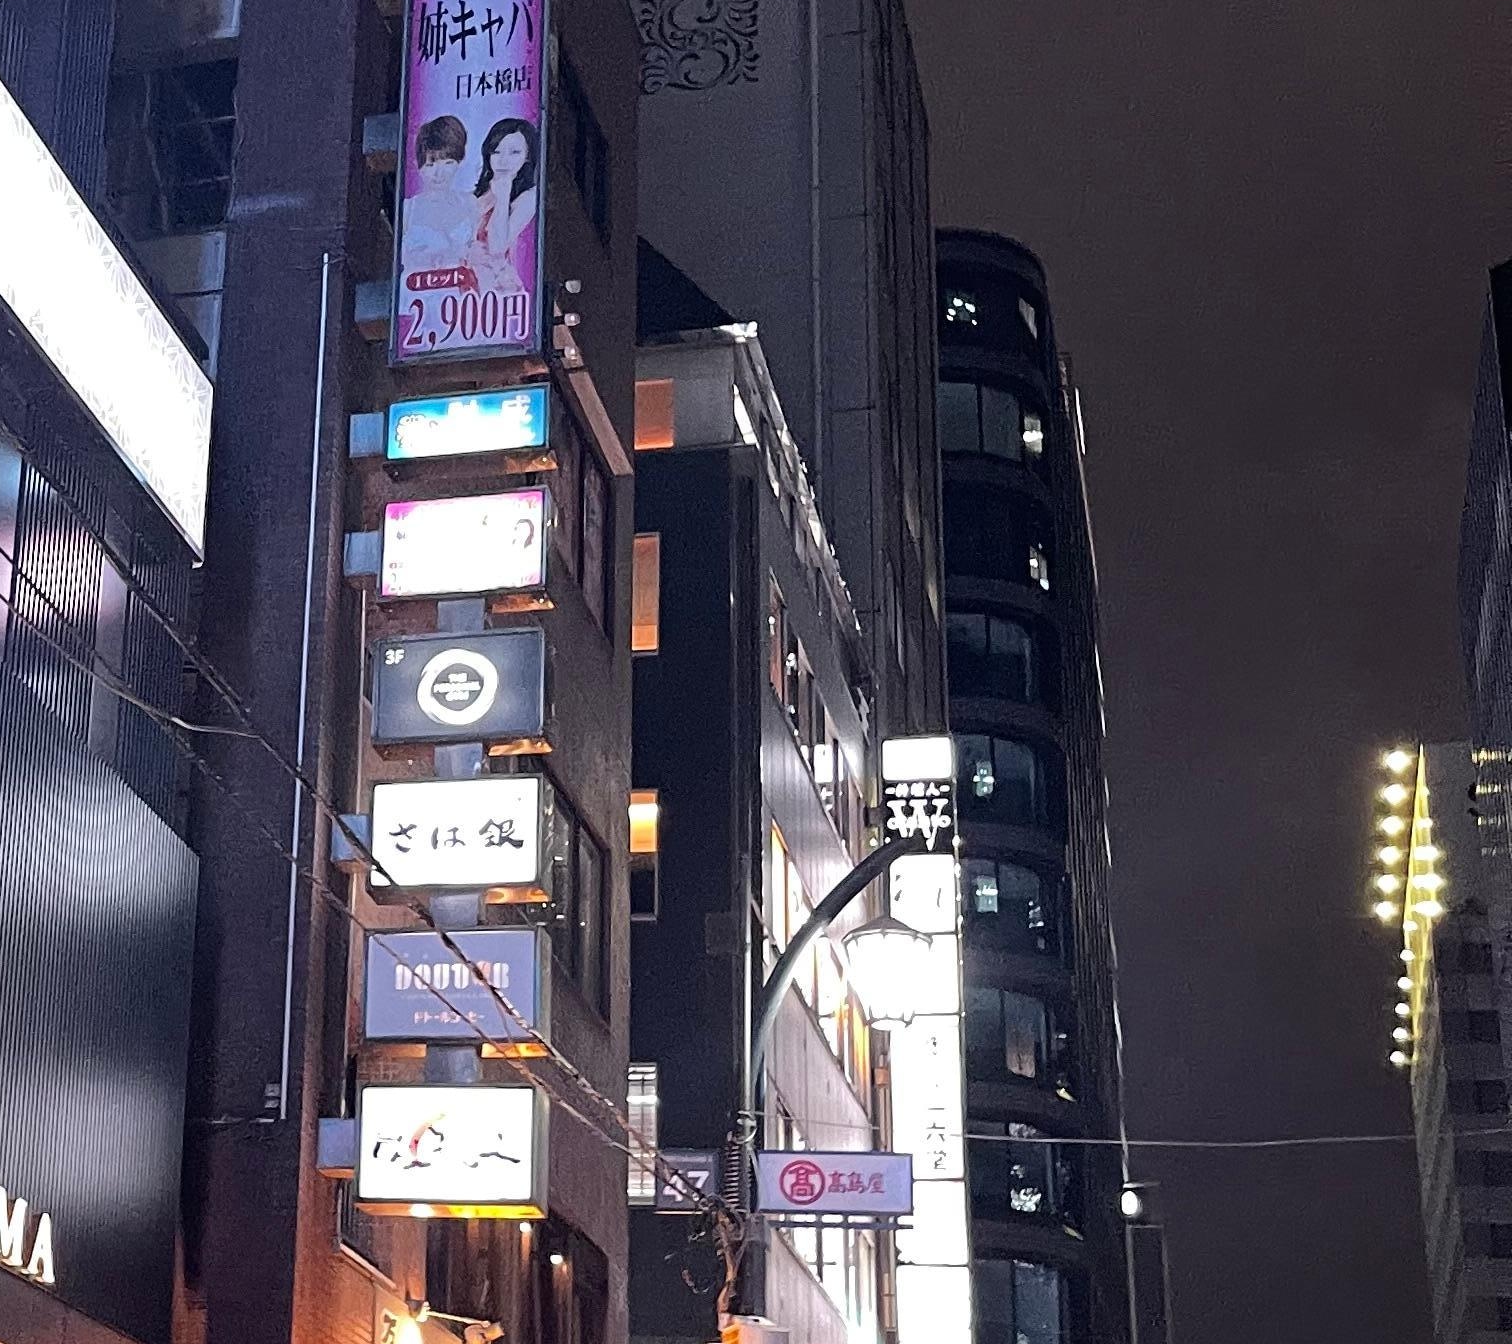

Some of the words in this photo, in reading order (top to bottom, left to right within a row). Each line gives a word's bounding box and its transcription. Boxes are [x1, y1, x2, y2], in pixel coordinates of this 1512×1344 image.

[456, 64, 533, 101] 日本橋店
[405, 289, 530, 353] 2,900円
[385, 648, 406, 665] 3F
[394, 961, 510, 990] DOUTOR
